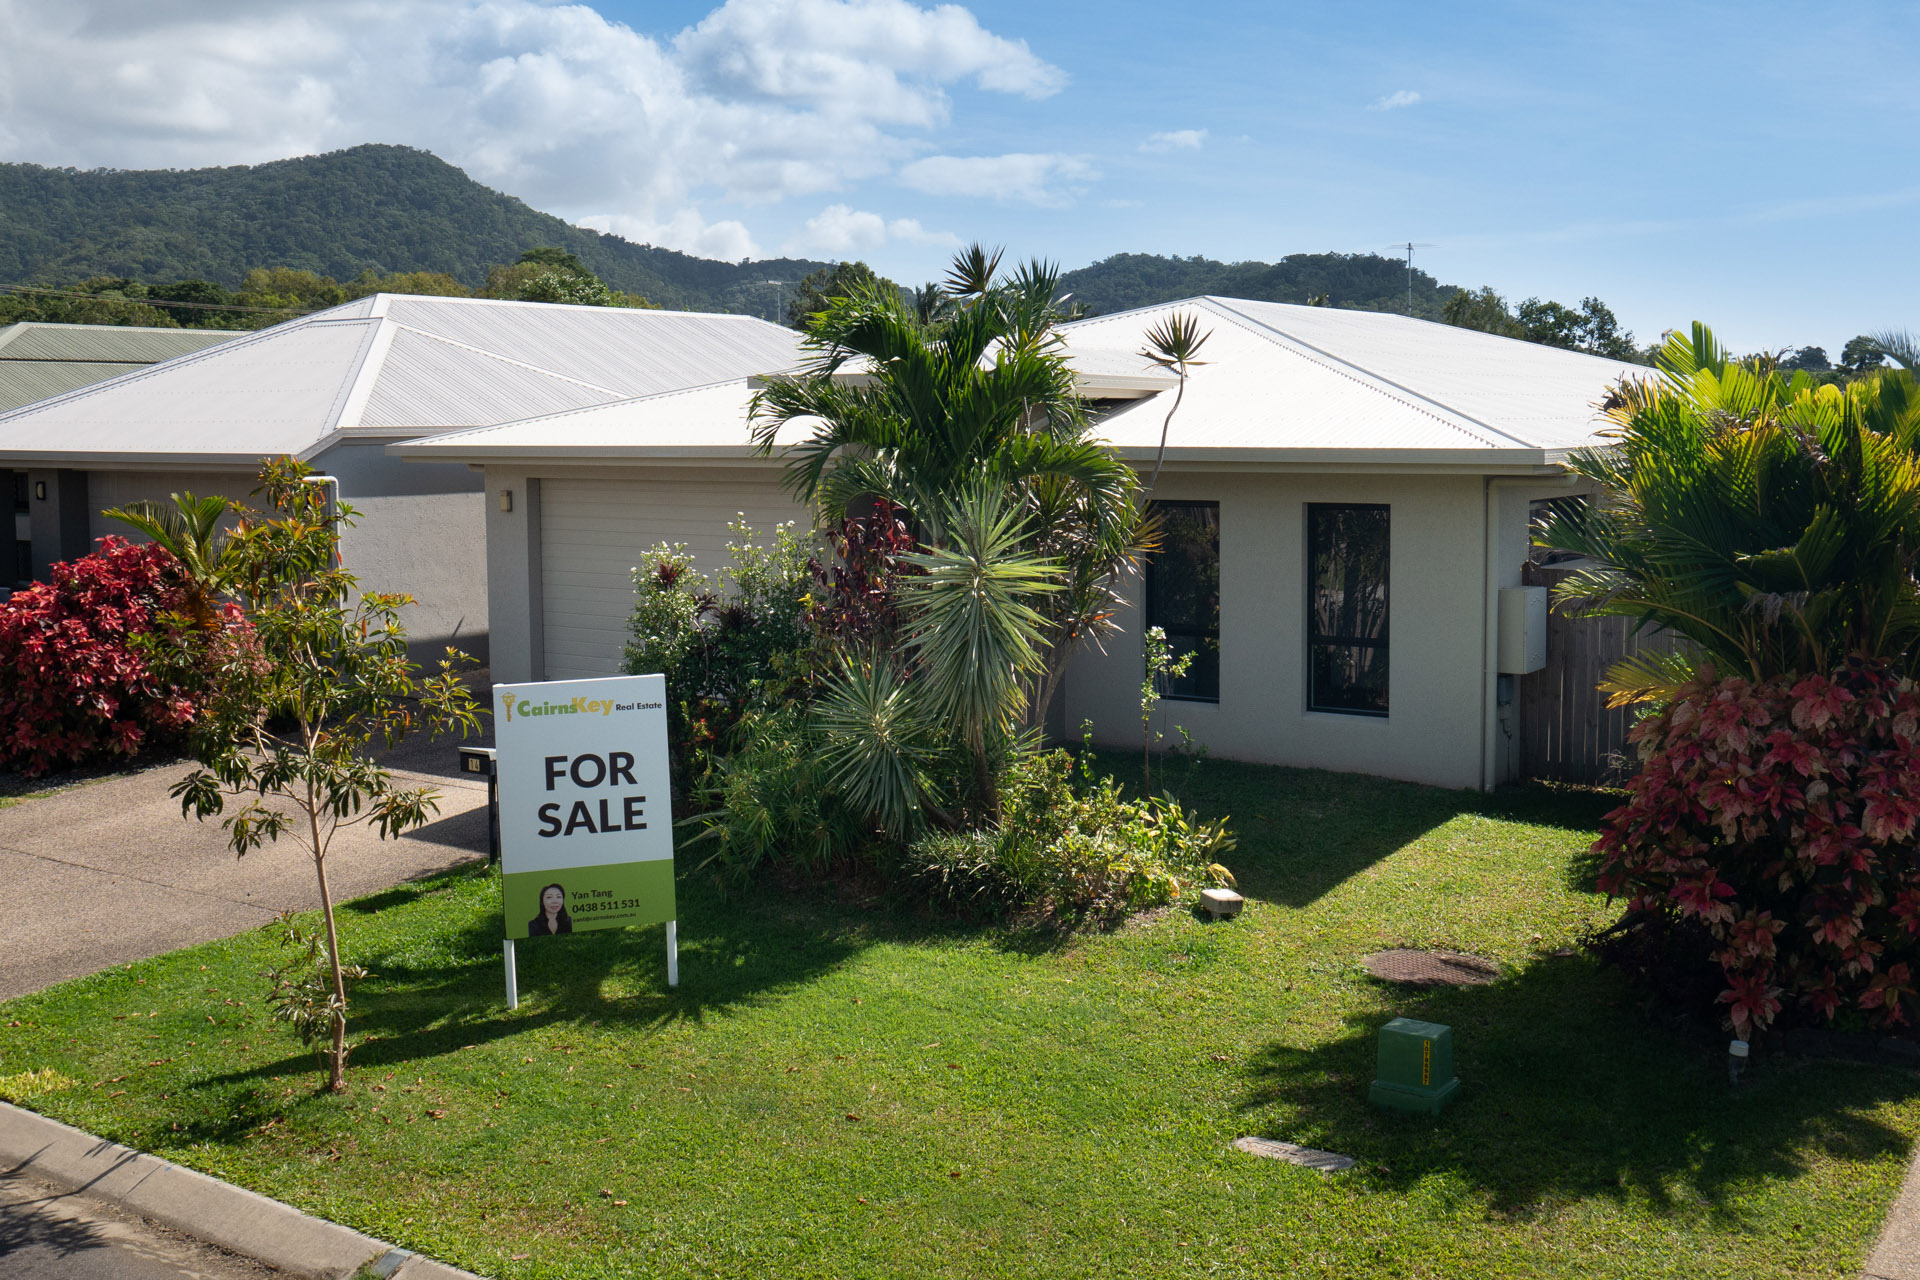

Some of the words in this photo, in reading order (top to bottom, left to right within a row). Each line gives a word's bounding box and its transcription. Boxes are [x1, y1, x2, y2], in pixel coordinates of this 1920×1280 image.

[615, 703, 635, 711] Real
[637, 702, 662, 710] Estate
[545, 752, 638, 791] FOR
[537, 796, 648, 838] SALE
[571, 891, 589, 899] Yan
[591, 890, 613, 898] Tang
[572, 903, 598, 913] 0438
[600, 901, 619, 911] 511
[621, 899, 640, 909] 531
